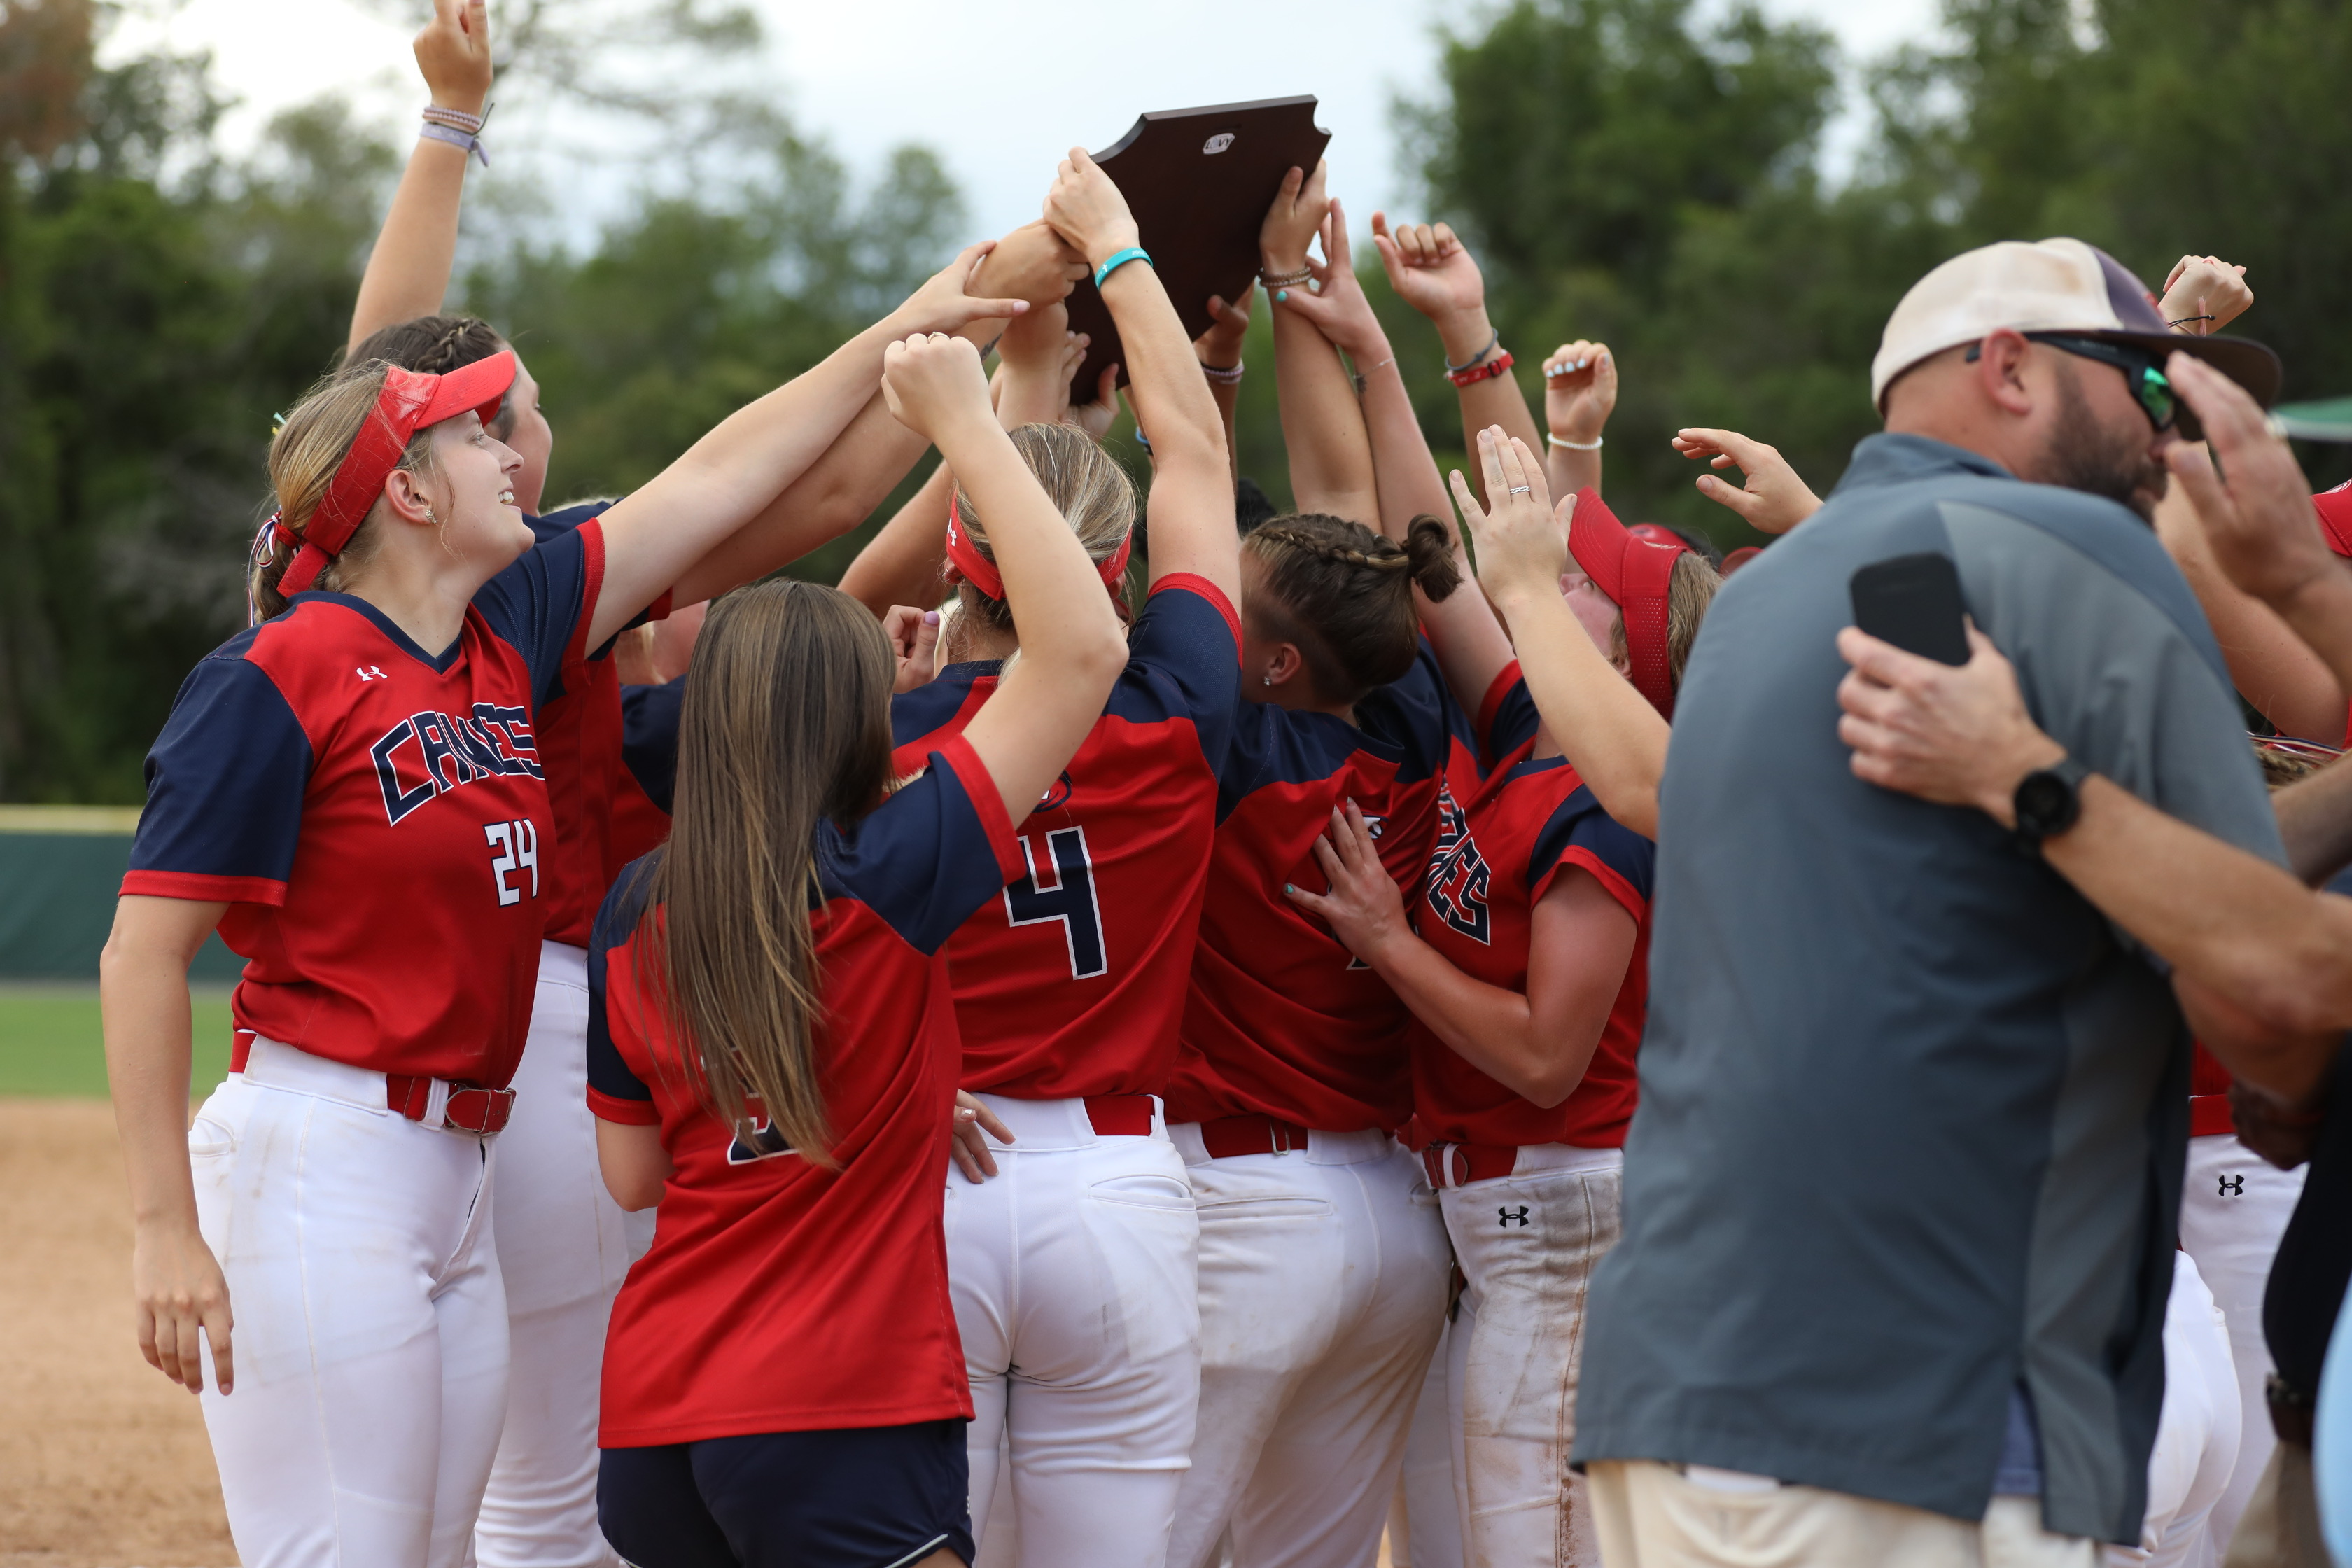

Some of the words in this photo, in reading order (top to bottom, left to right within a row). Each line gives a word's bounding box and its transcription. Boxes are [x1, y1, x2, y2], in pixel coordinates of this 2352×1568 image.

[370, 701, 546, 827] CANES
[483, 818, 538, 907] 24
[1002, 825, 1108, 981] 4
